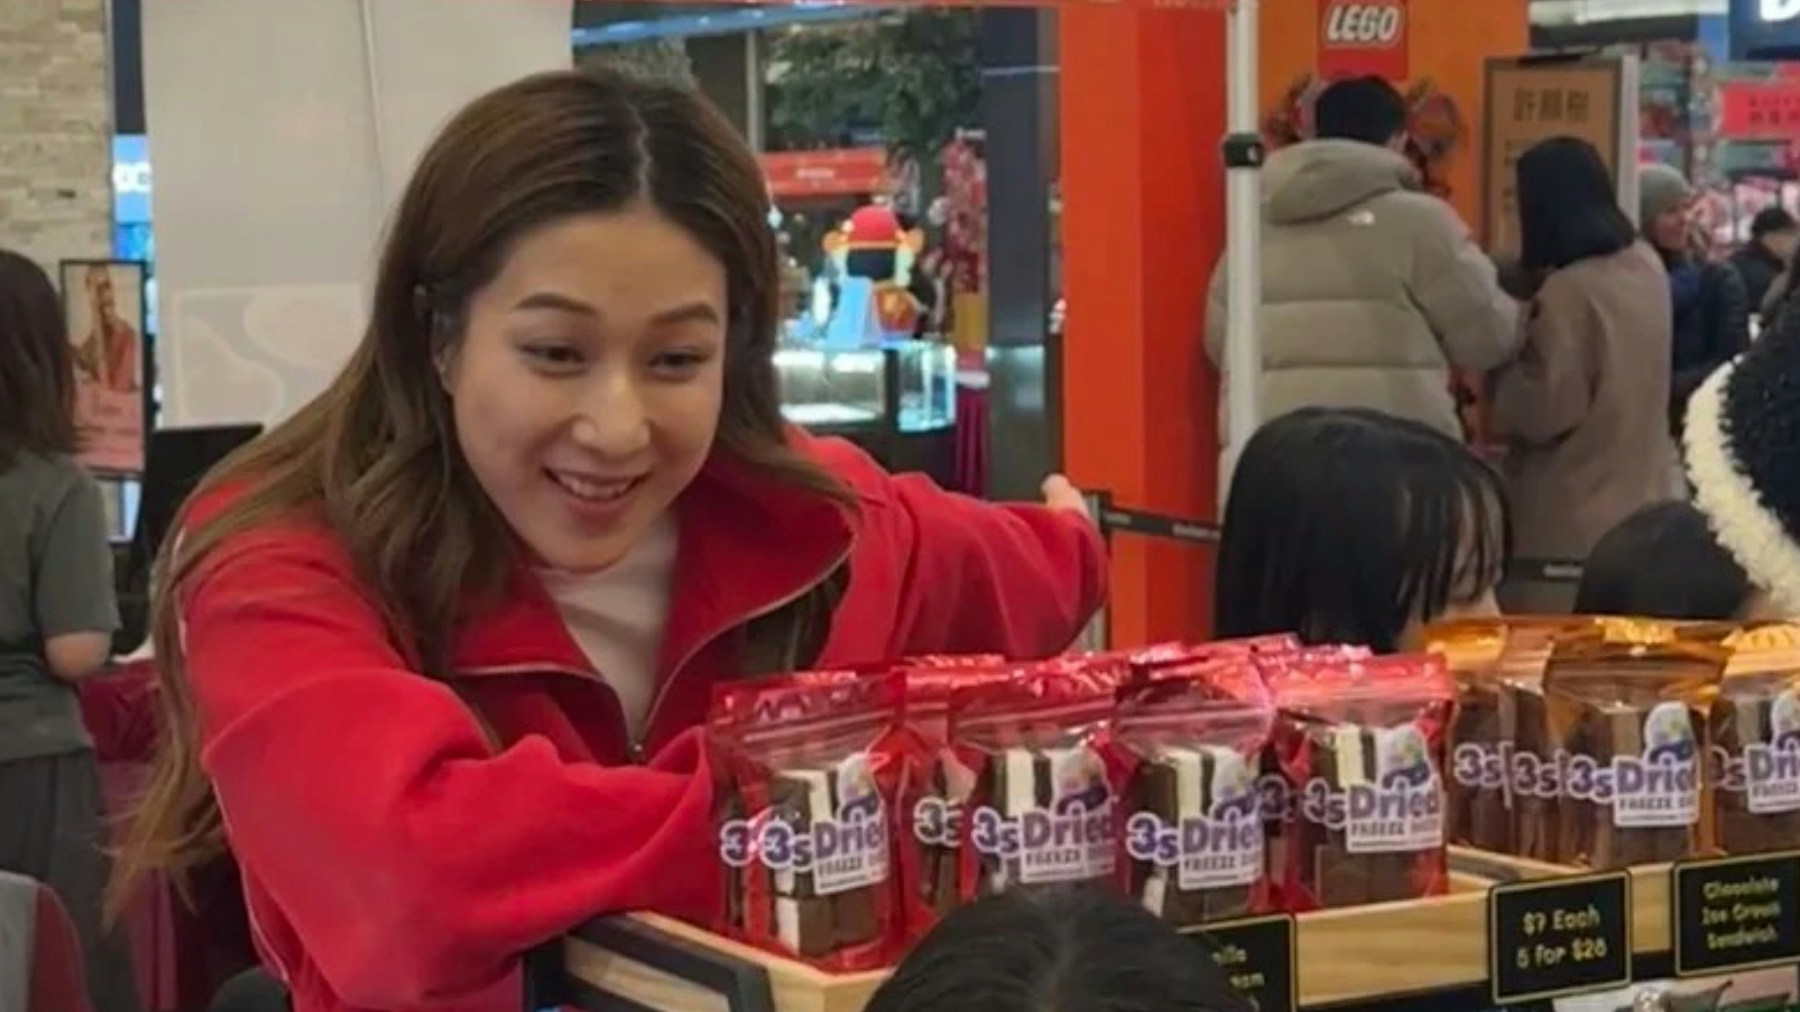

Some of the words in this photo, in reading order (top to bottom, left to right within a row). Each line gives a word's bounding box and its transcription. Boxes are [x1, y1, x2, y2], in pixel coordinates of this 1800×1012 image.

[1327, 5, 1399, 41] LEGO
[1553, 903, 1600, 930] Each
[1534, 942, 1567, 967] for
